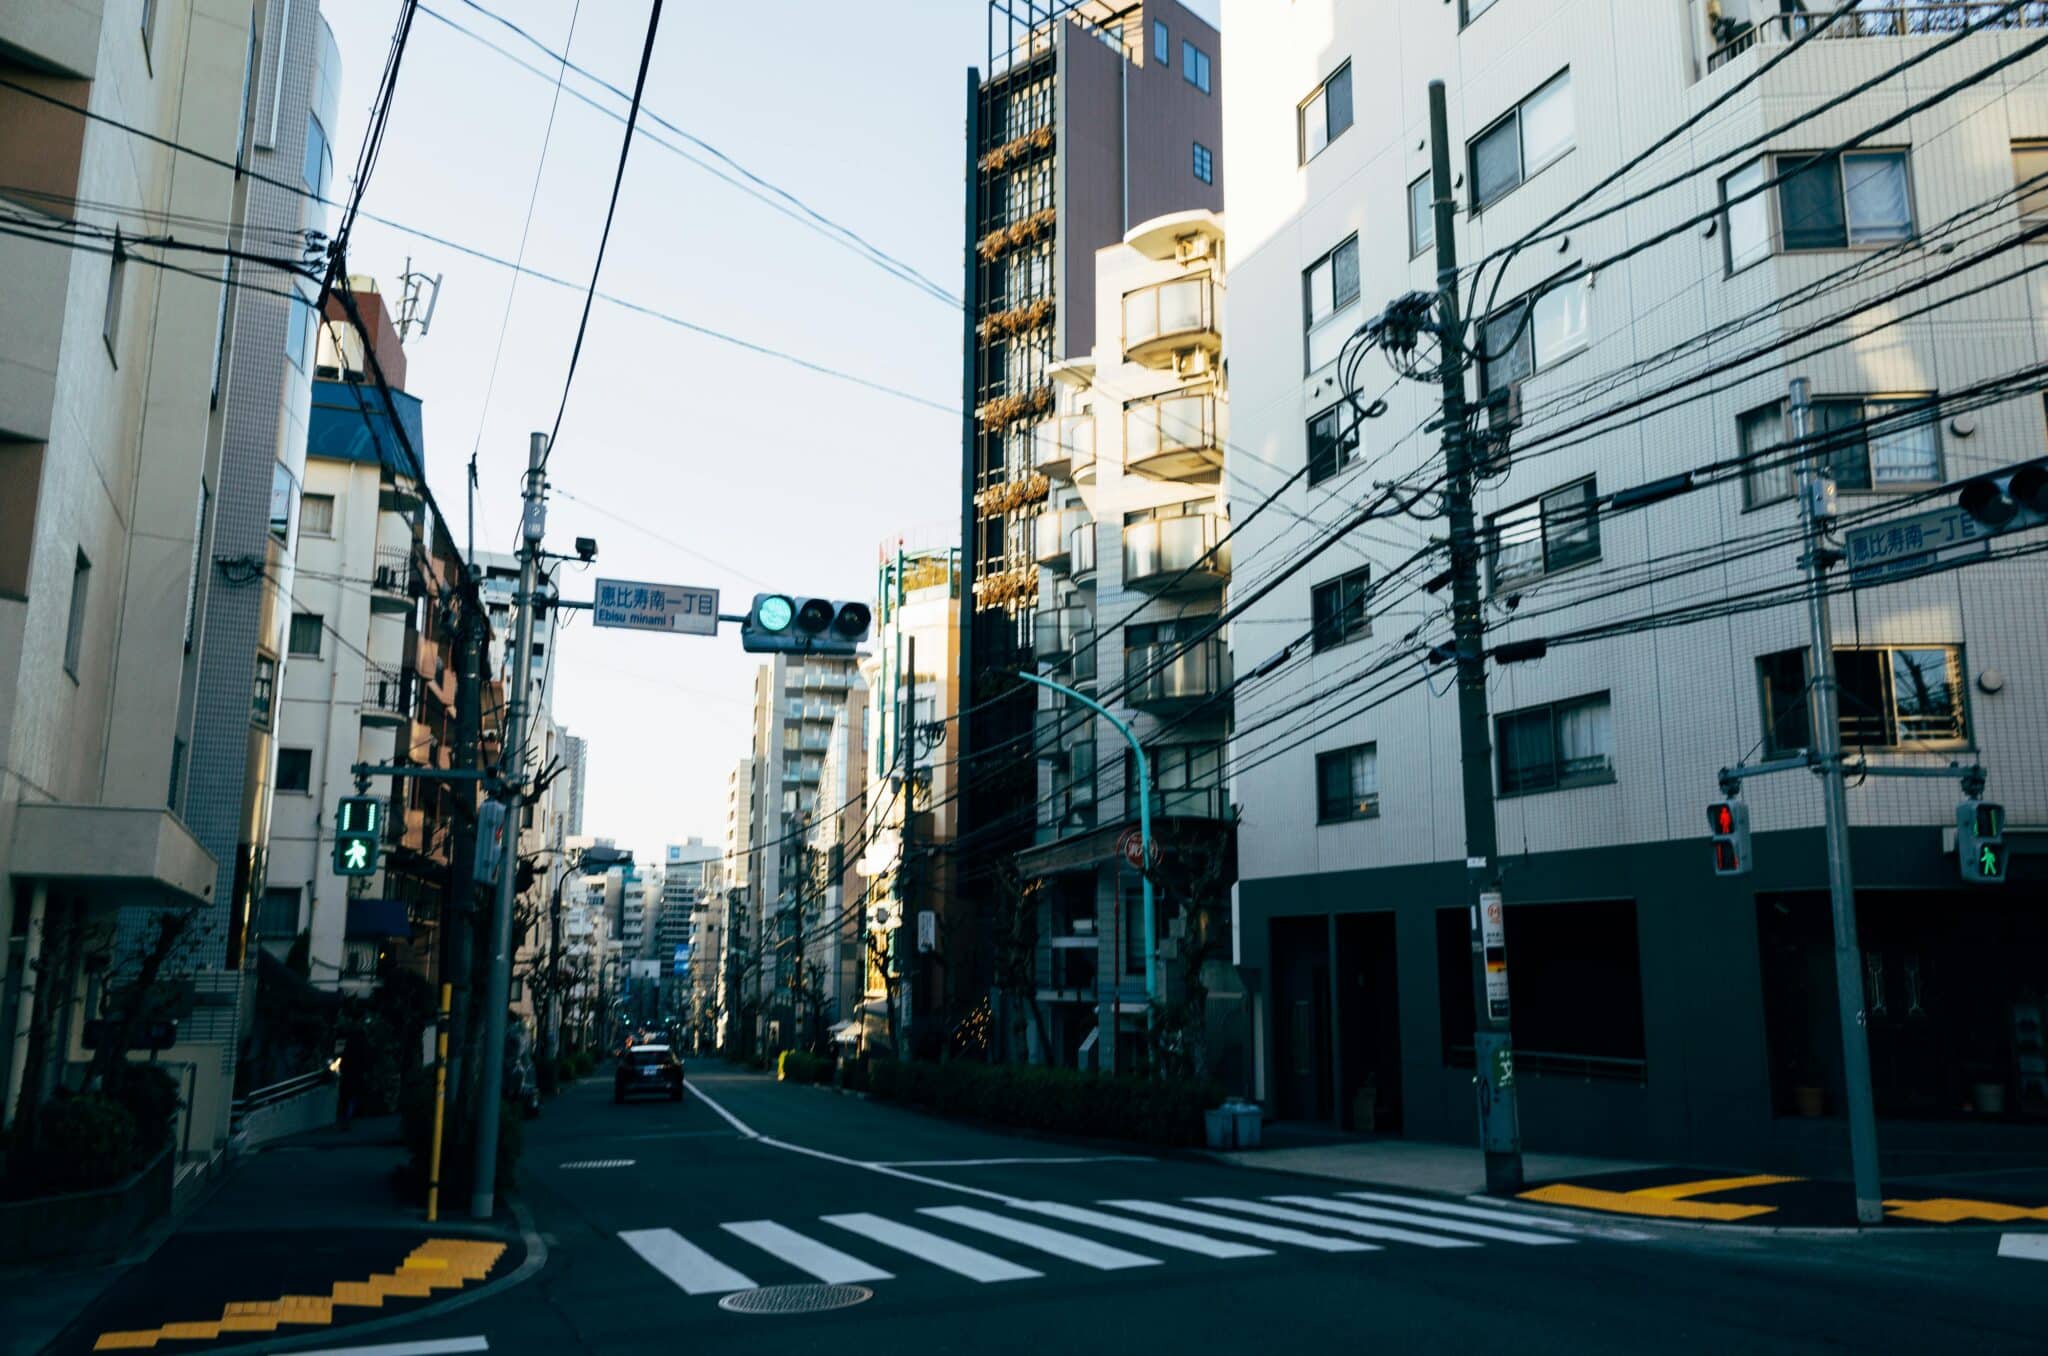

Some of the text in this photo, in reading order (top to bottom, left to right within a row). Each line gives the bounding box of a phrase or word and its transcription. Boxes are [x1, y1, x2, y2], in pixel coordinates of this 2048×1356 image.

[600, 586, 712, 615] 恵比寿南一丁目
[599, 608, 626, 623] Ebisu
[630, 613, 666, 625] minami
